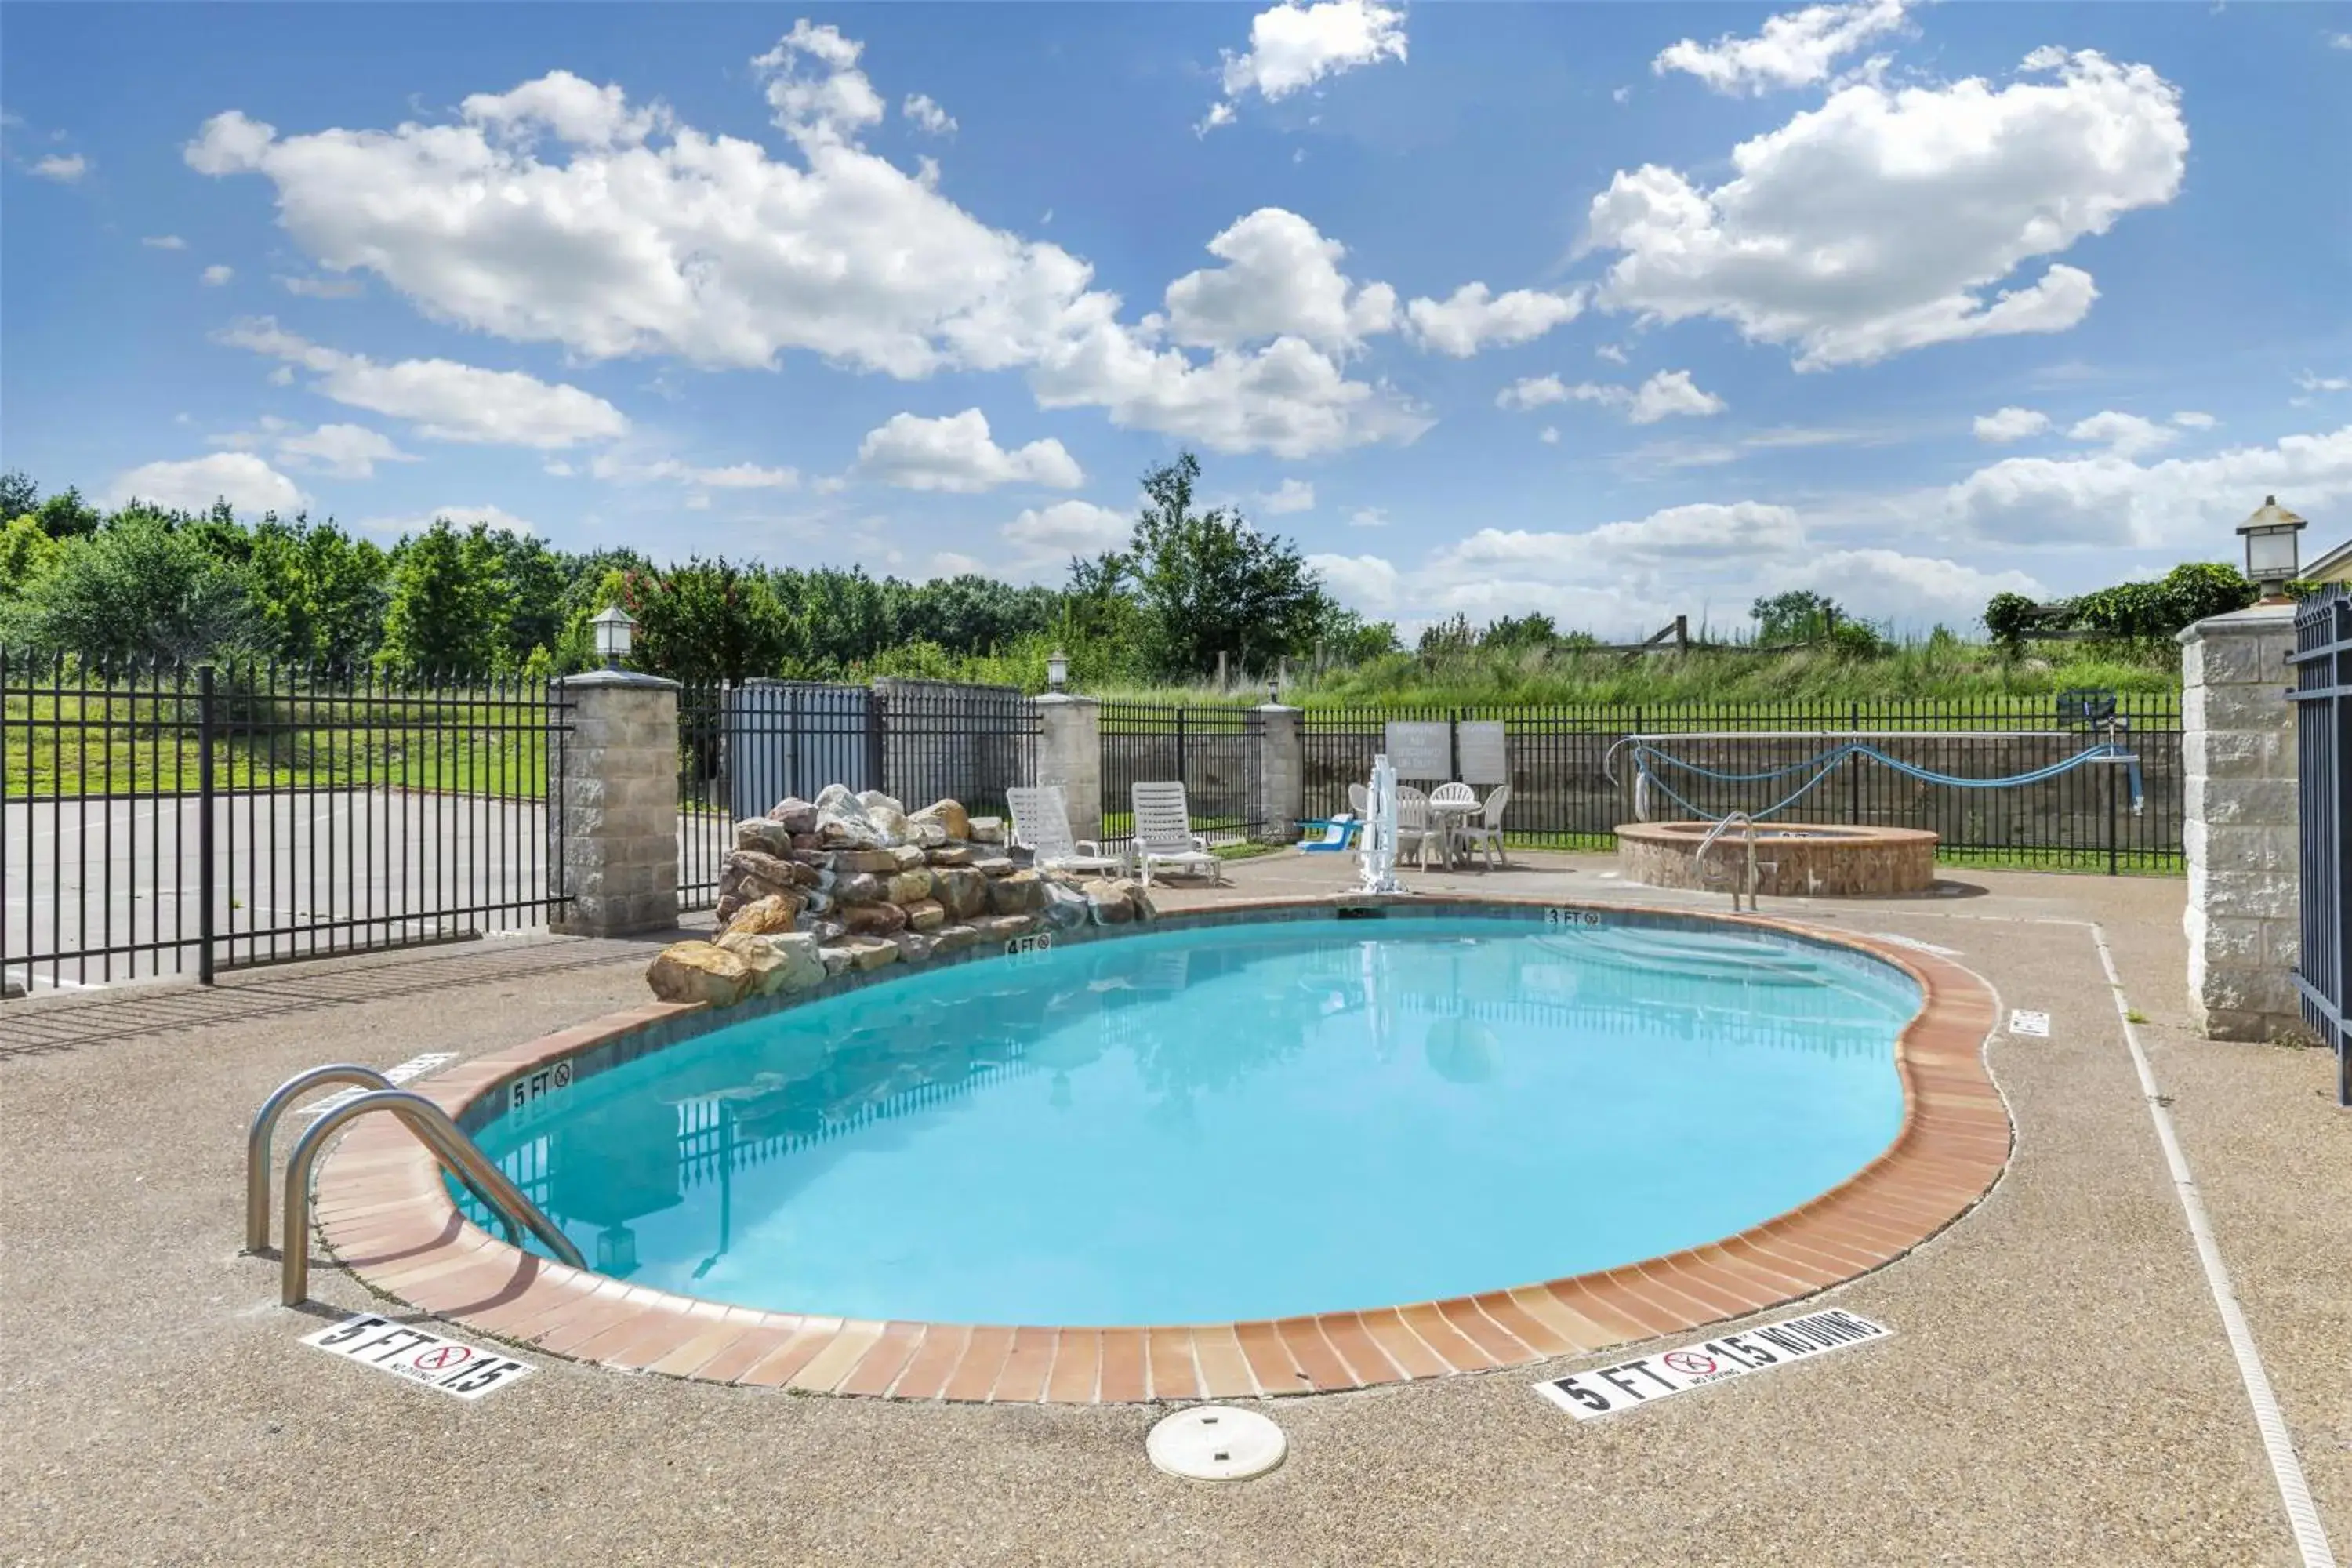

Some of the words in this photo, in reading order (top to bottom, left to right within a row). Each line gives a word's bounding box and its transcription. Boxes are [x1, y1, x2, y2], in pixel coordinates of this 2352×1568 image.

[1549, 909, 1558, 926] 3
[1564, 911, 1581, 926] FT
[1007, 939, 1018, 954] 4
[1022, 938, 1034, 954] FT
[514, 1083, 524, 1109] 5
[531, 1072, 549, 1102] FT
[318, 1318, 388, 1346] 5
[347, 1328, 440, 1363] FT
[1752, 1327, 1818, 1356] NO
[1783, 1310, 1882, 1348] DIVING
[1553, 1377, 1611, 1411] 5
[1599, 1360, 1680, 1401] FT
